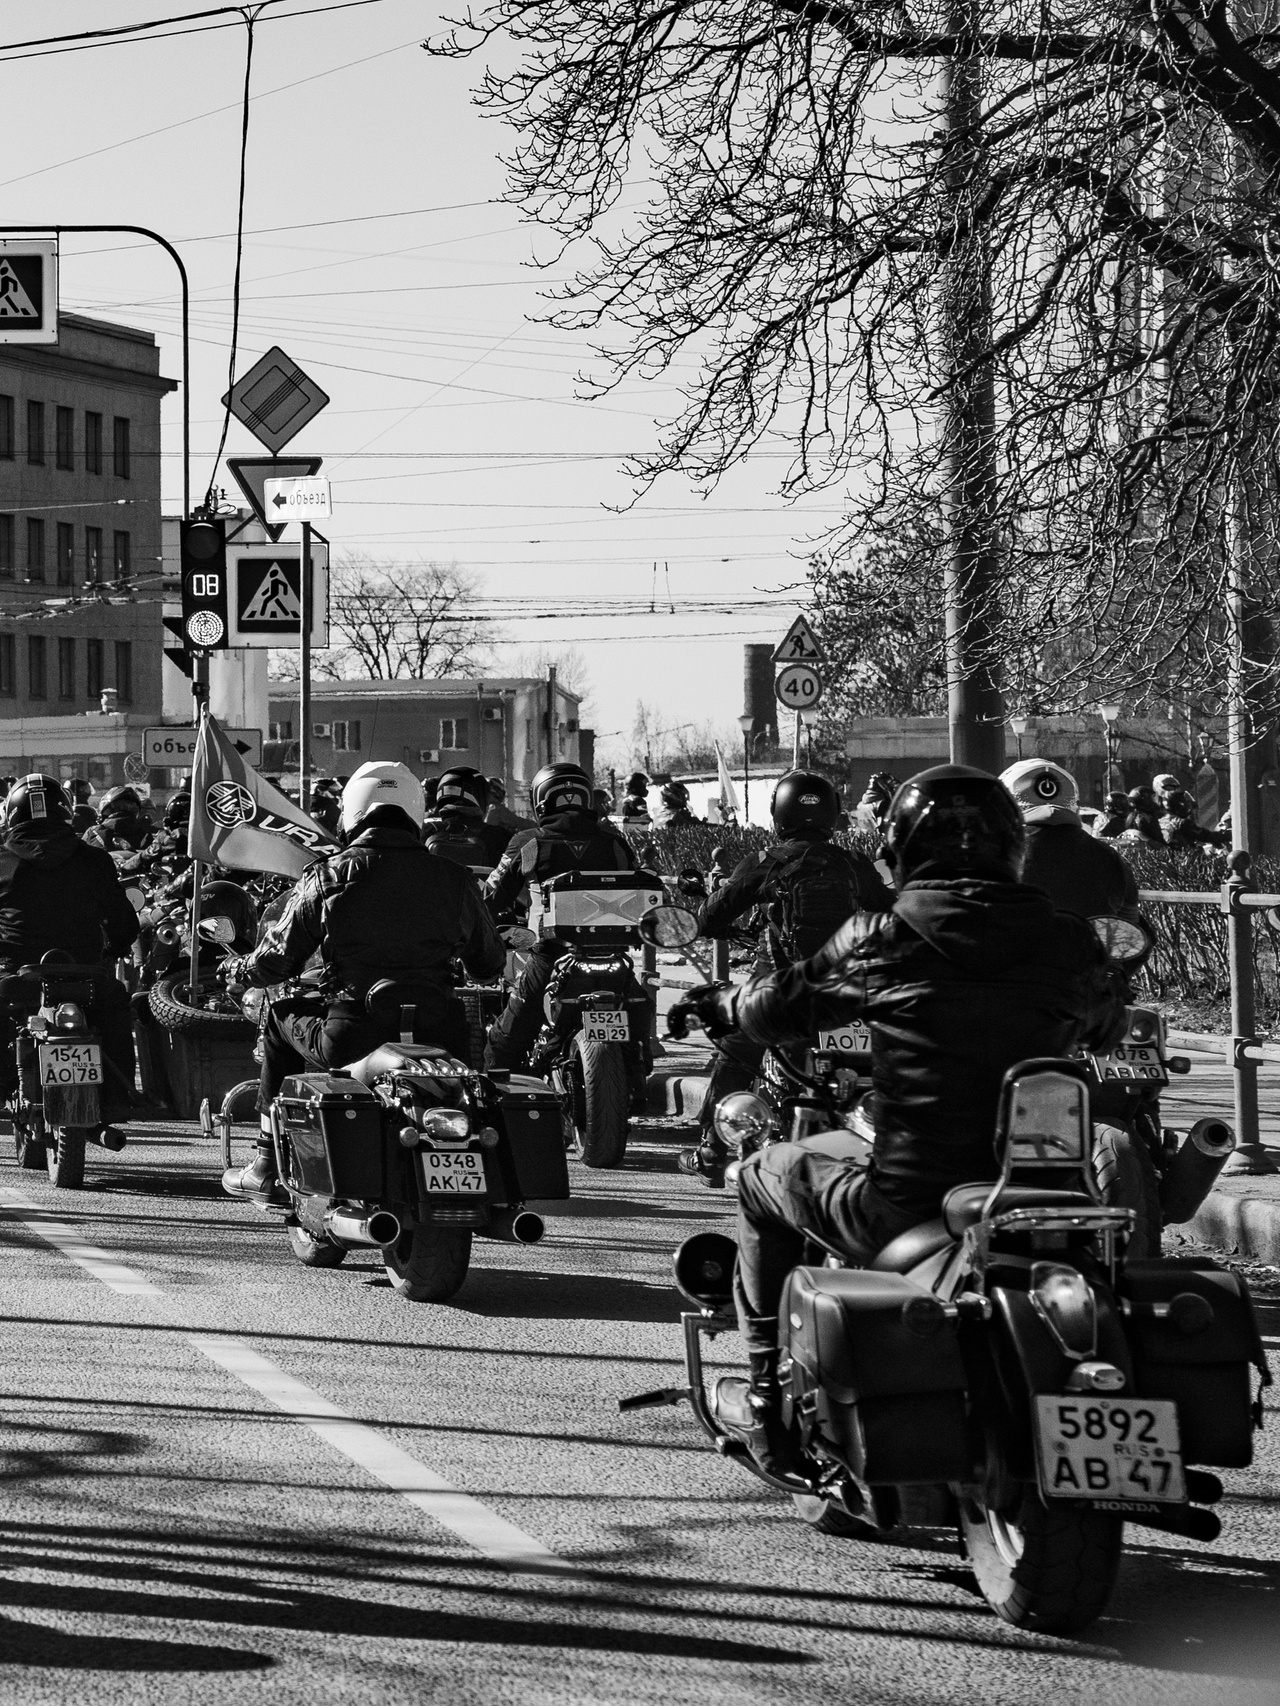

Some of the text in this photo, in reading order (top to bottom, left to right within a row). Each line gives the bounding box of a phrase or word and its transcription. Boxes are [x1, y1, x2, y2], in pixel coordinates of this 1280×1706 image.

[289, 490, 326, 506] объезд
[193, 574, 219, 596] 08
[784, 678, 815, 697] 40
[152, 738, 197, 754] объе
[259, 815, 341, 855] URA
[589, 1012, 623, 1024] 5521
[587, 1029, 627, 1040] AB 29
[826, 1035, 869, 1050] AO 7
[50, 1048, 92, 1062] 1541
[1114, 1049, 1151, 1060] 078
[45, 1068, 99, 1083] AO 78
[429, 1154, 476, 1168] 0348
[429, 1175, 482, 1190] AK 47
[1058, 1405, 1158, 1443] 5892
[1113, 1443, 1149, 1458] RUS
[1054, 1456, 1173, 1493] AB 47
[1092, 1500, 1161, 1514] HONDA
